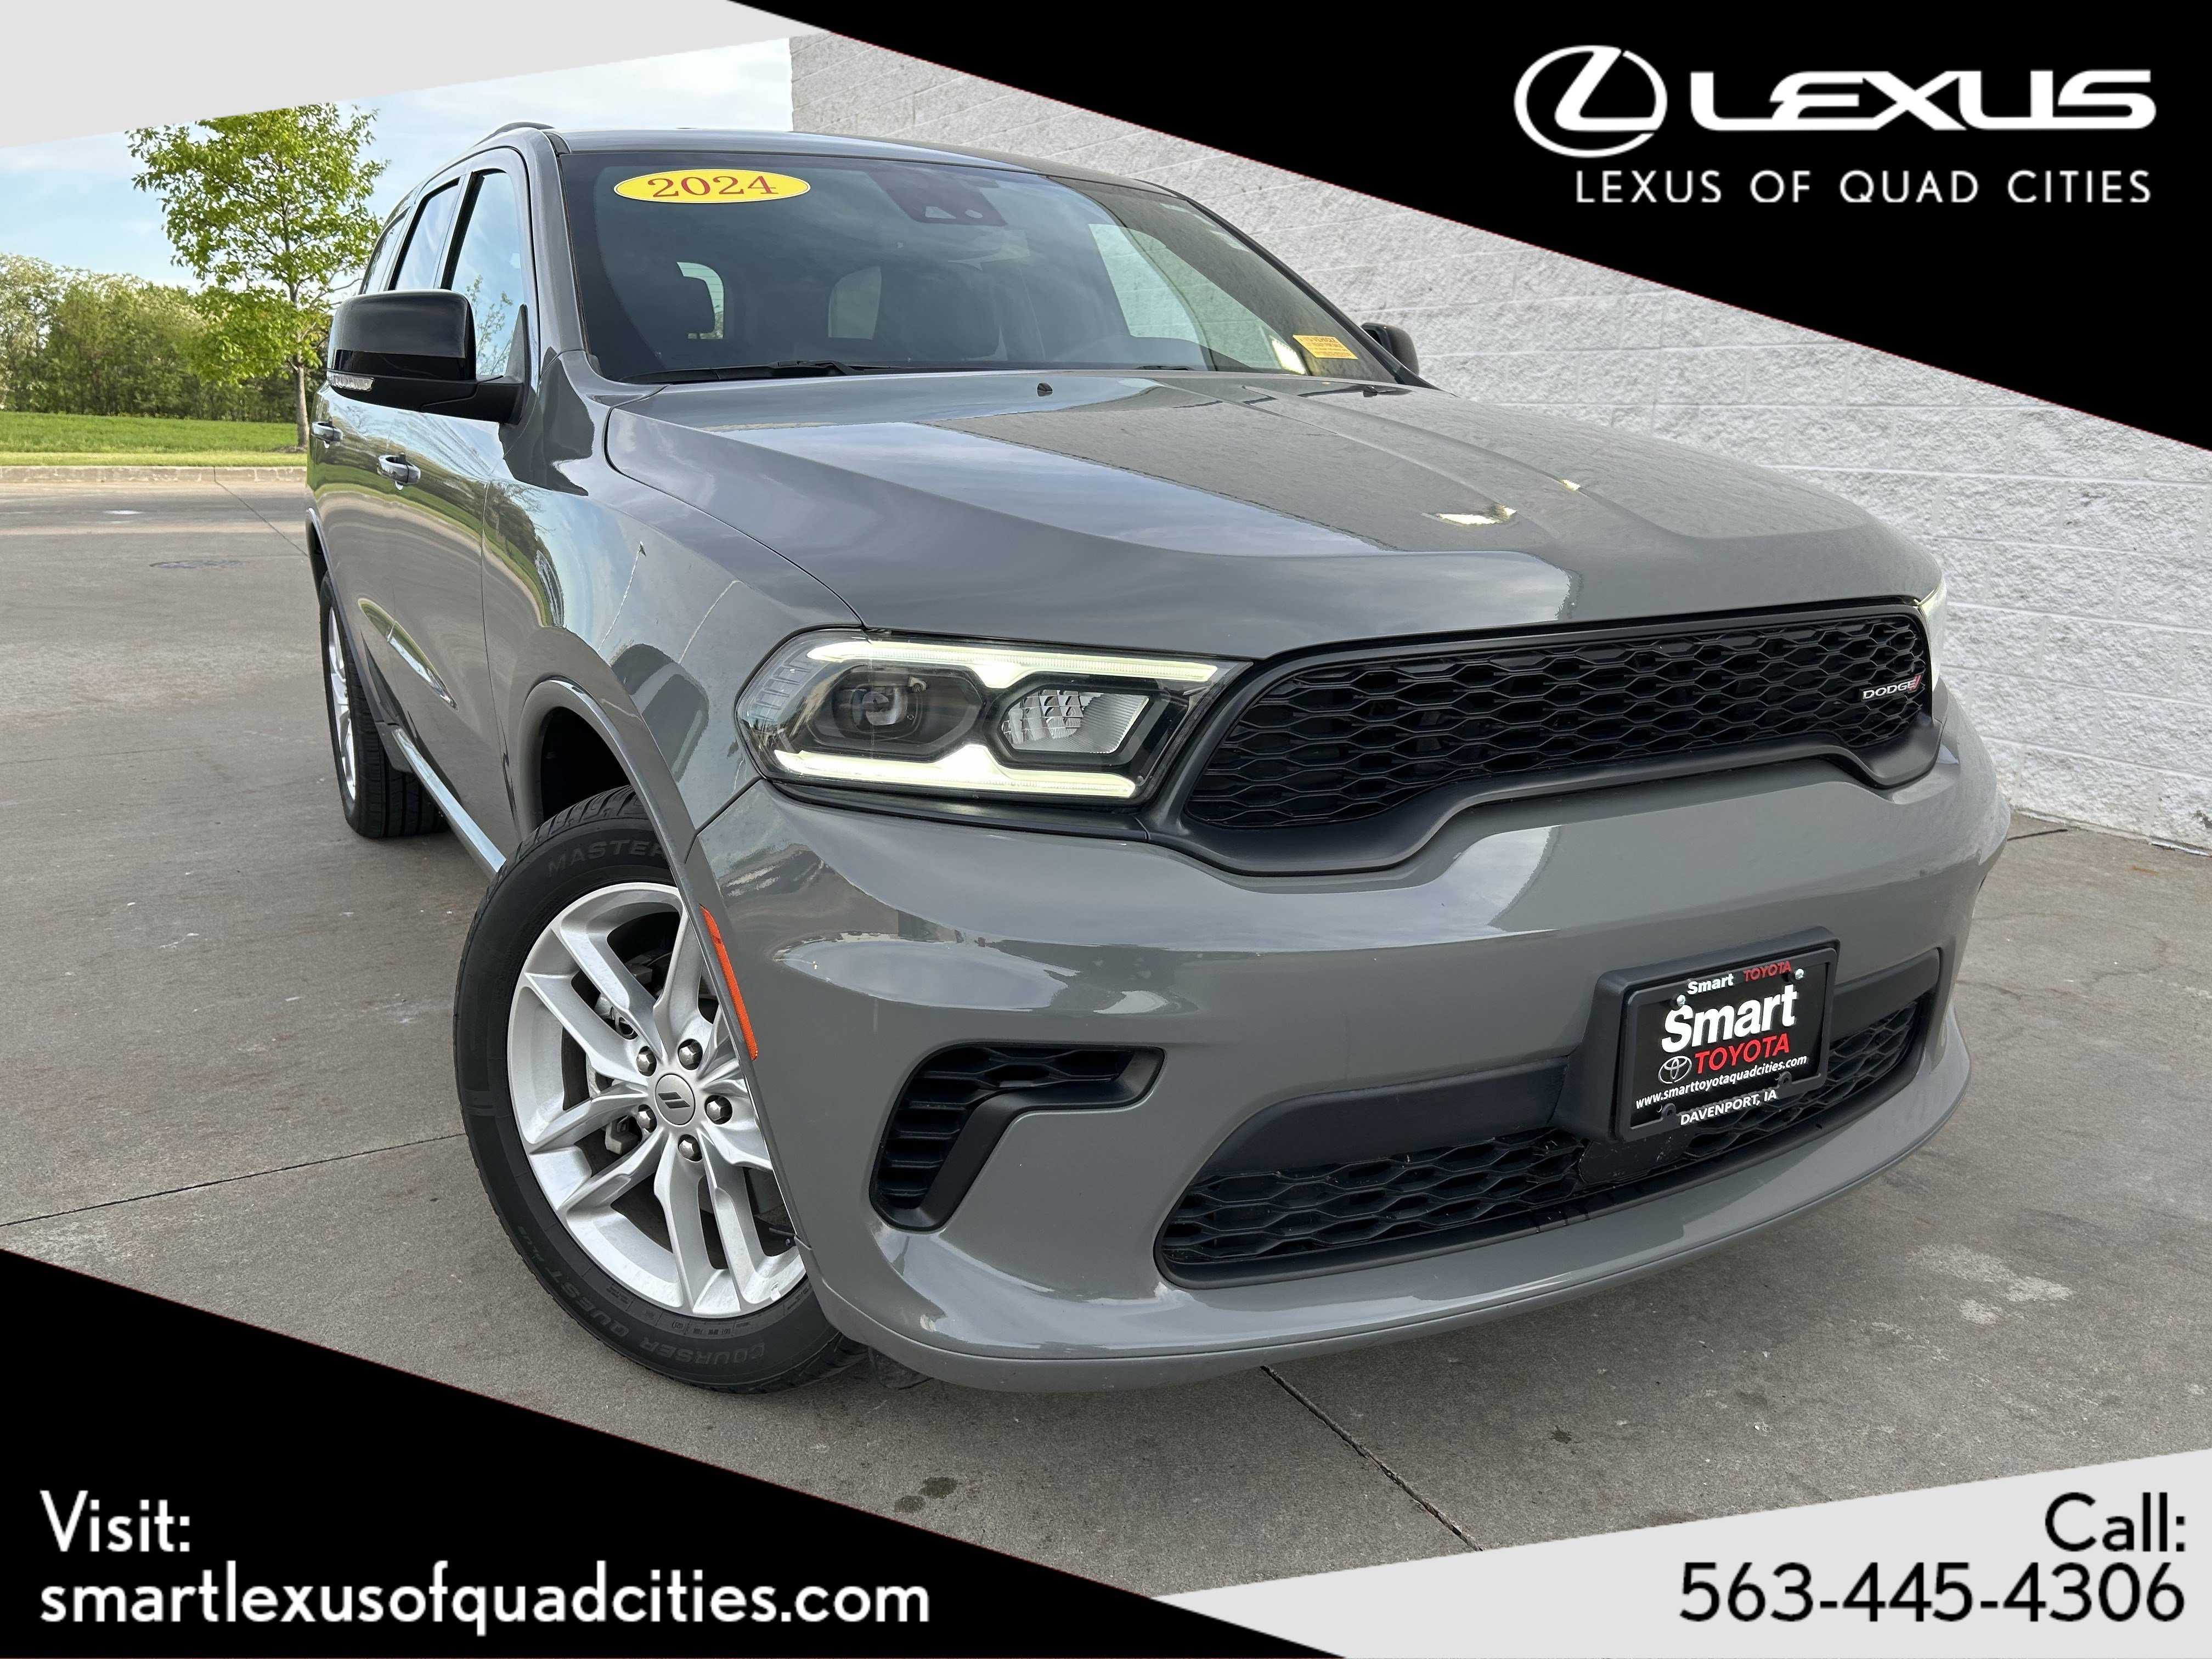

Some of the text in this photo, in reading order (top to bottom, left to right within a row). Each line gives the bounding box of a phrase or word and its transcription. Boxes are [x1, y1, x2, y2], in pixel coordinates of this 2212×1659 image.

[647, 176, 779, 198] 2024
[1863, 680, 1916, 700] DODGE
[1687, 961, 1792, 995] Smart TOYOTA
[1661, 984, 1800, 1053] Smart
[1695, 1032, 1791, 1074] TOYOTA
[1635, 1054, 1807, 1109] www.smarttoyotaquadcities.com
[1680, 1089, 1777, 1126] DAVENPORT, IA
[545, 1267, 629, 1338] QUEST
[639, 1336, 765, 1365] COURSER
